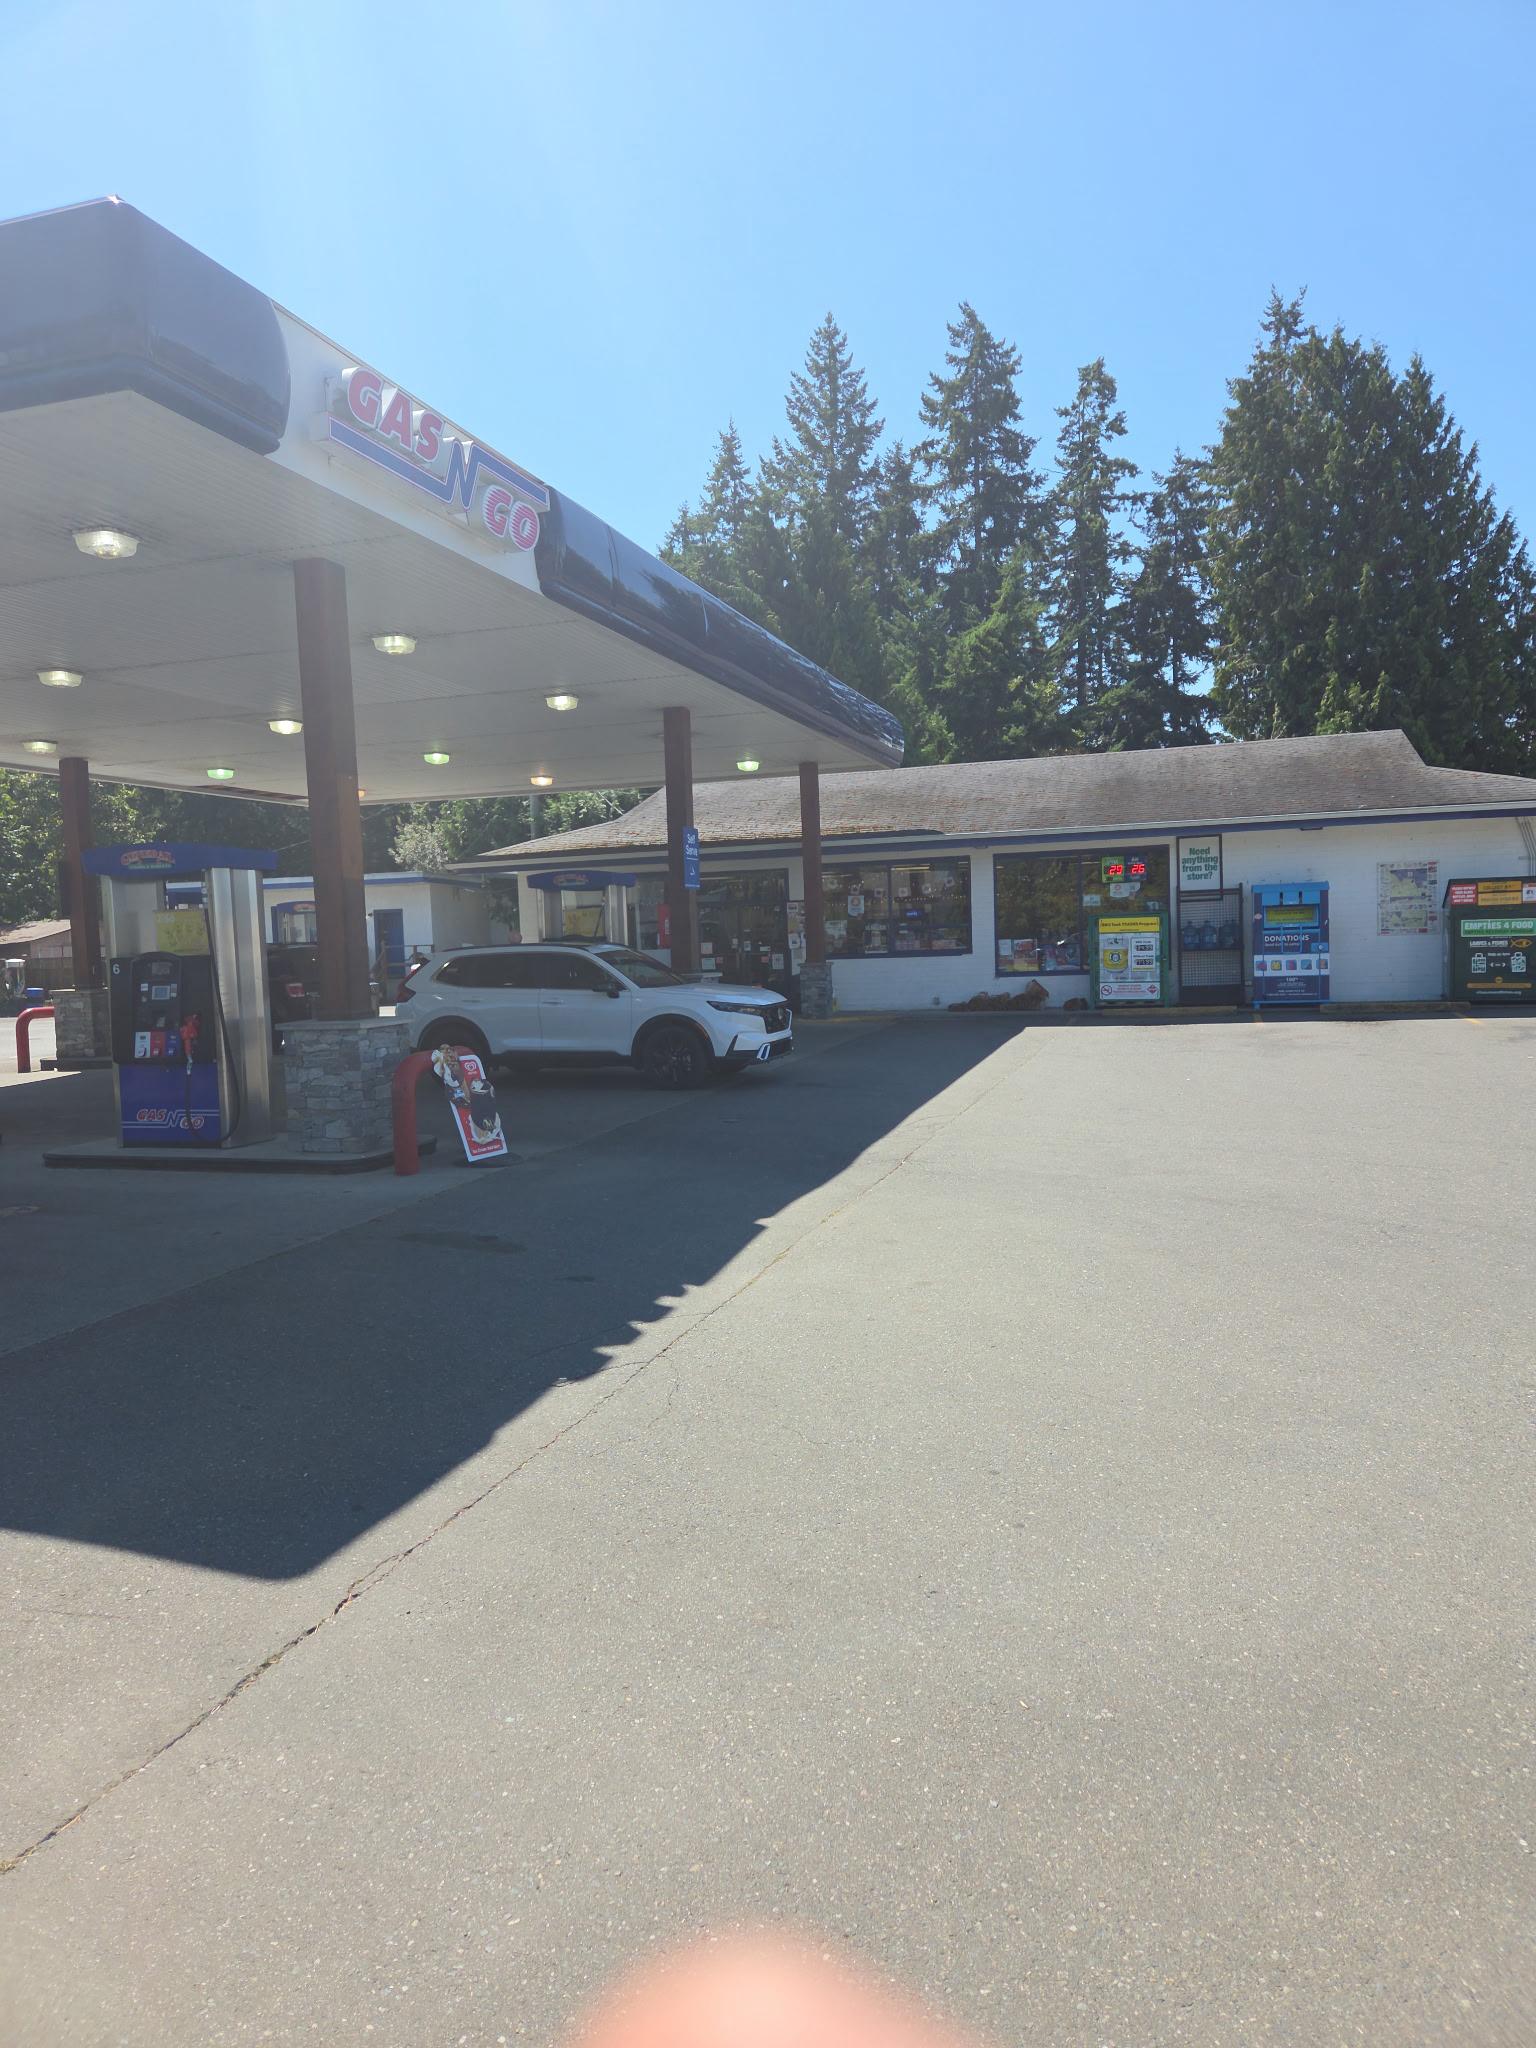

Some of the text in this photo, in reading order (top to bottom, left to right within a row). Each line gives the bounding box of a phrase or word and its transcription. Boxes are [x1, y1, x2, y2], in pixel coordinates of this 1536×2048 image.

[347, 367, 444, 462] GAS
[484, 485, 539, 551] GO
[1189, 846, 1210, 856] Need
[1182, 856, 1218, 866] anything
[1109, 864, 1123, 876] 29
[1131, 863, 1145, 874] 26
[1182, 863, 1218, 873] from the
[1187, 871, 1213, 881] store?
[1464, 921, 1534, 930] EMPTIES 4 FOOD
[1264, 935, 1310, 943] DONATIONS
[113, 963, 120, 975] 6
[136, 1108, 168, 1122] GAS
